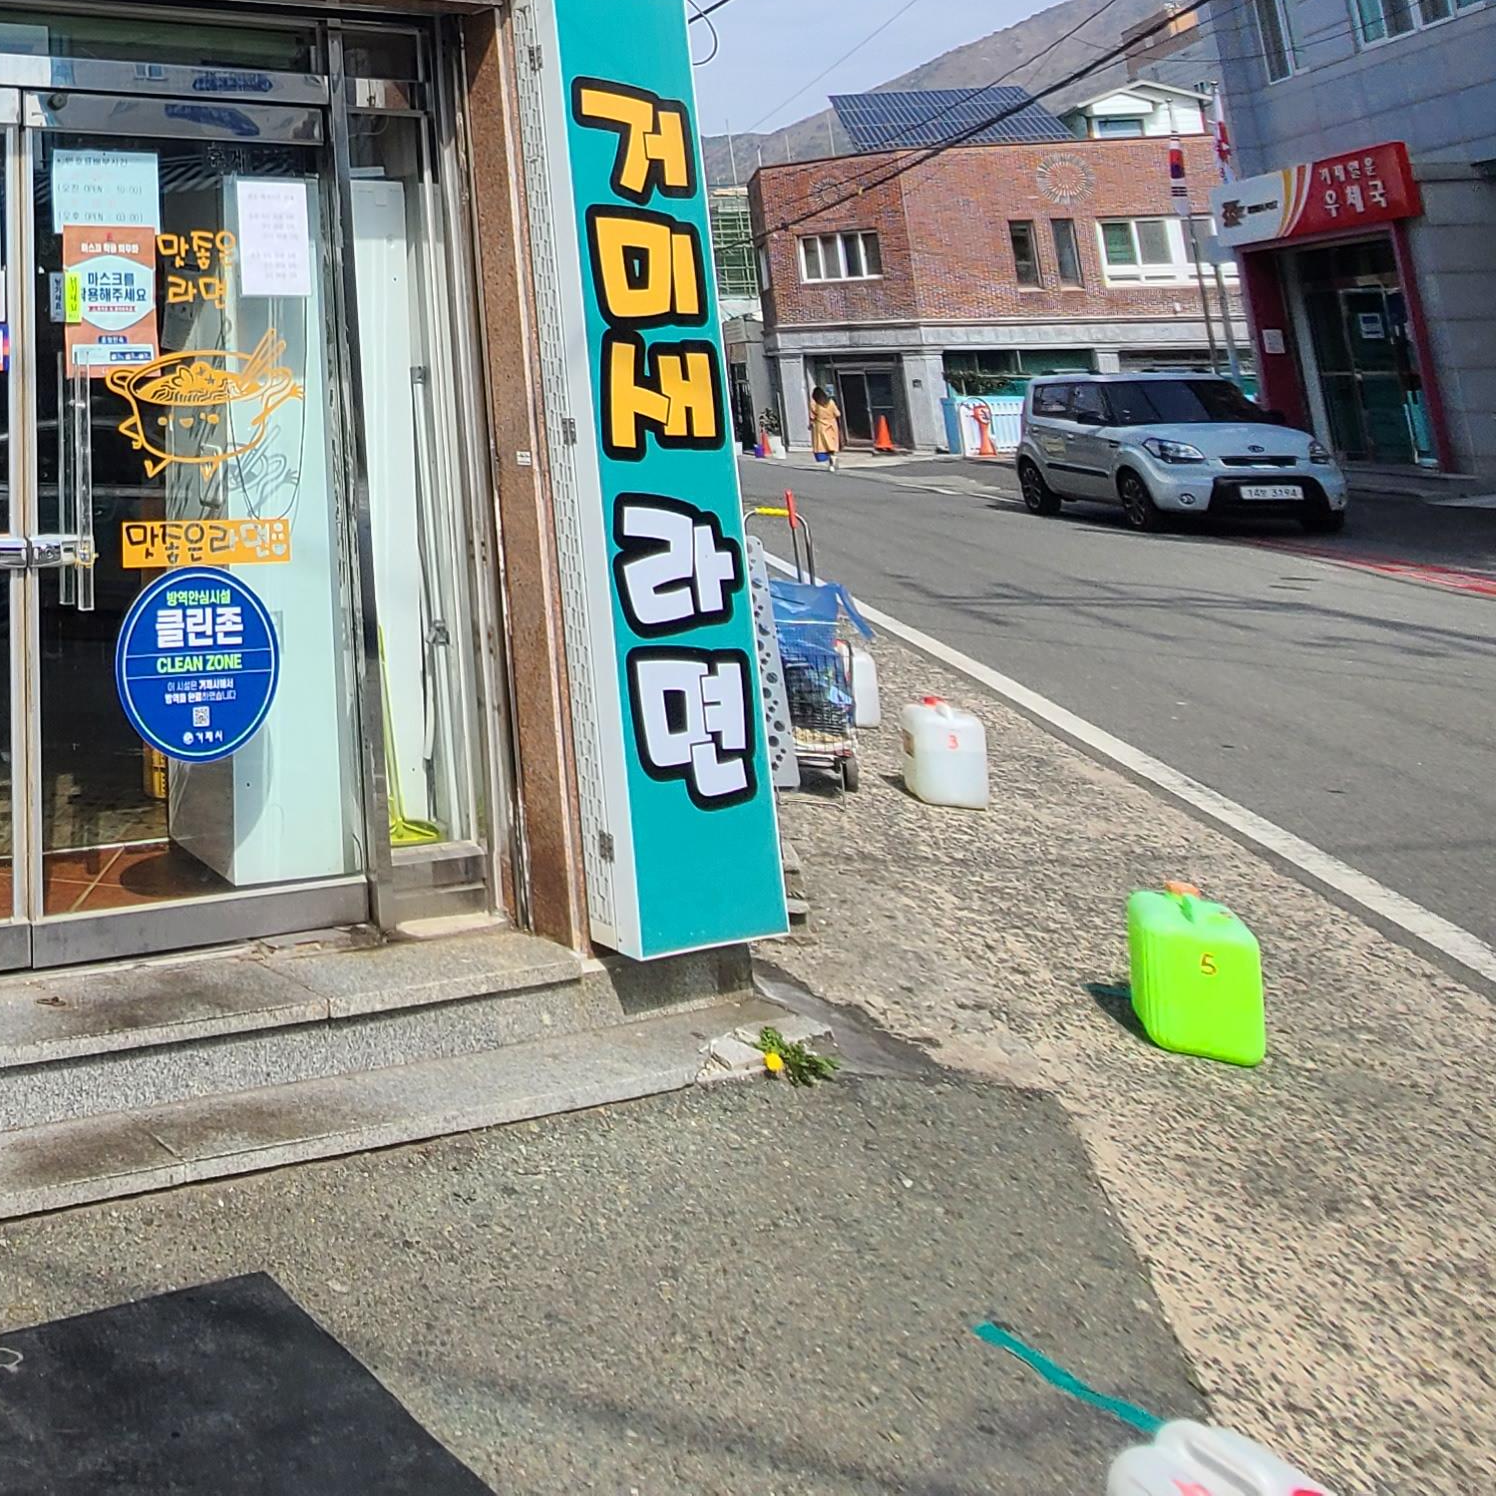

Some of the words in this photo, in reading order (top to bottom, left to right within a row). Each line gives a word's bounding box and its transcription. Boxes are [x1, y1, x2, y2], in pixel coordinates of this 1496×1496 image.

[1324, 180, 1388, 218] 우체국
[156, 230, 237, 270] 맛좋은
[87, 271, 135, 287] 마스크를
[167, 275, 227, 310] 라면
[166, 589, 231, 606] 방역안심시설
[155, 606, 244, 648] 클린존
[156, 655, 204, 673] CLEAN
[206, 653, 243, 671] ZONE
[616, 498, 754, 804] 라면
[1200, 953, 1217, 976] 5
